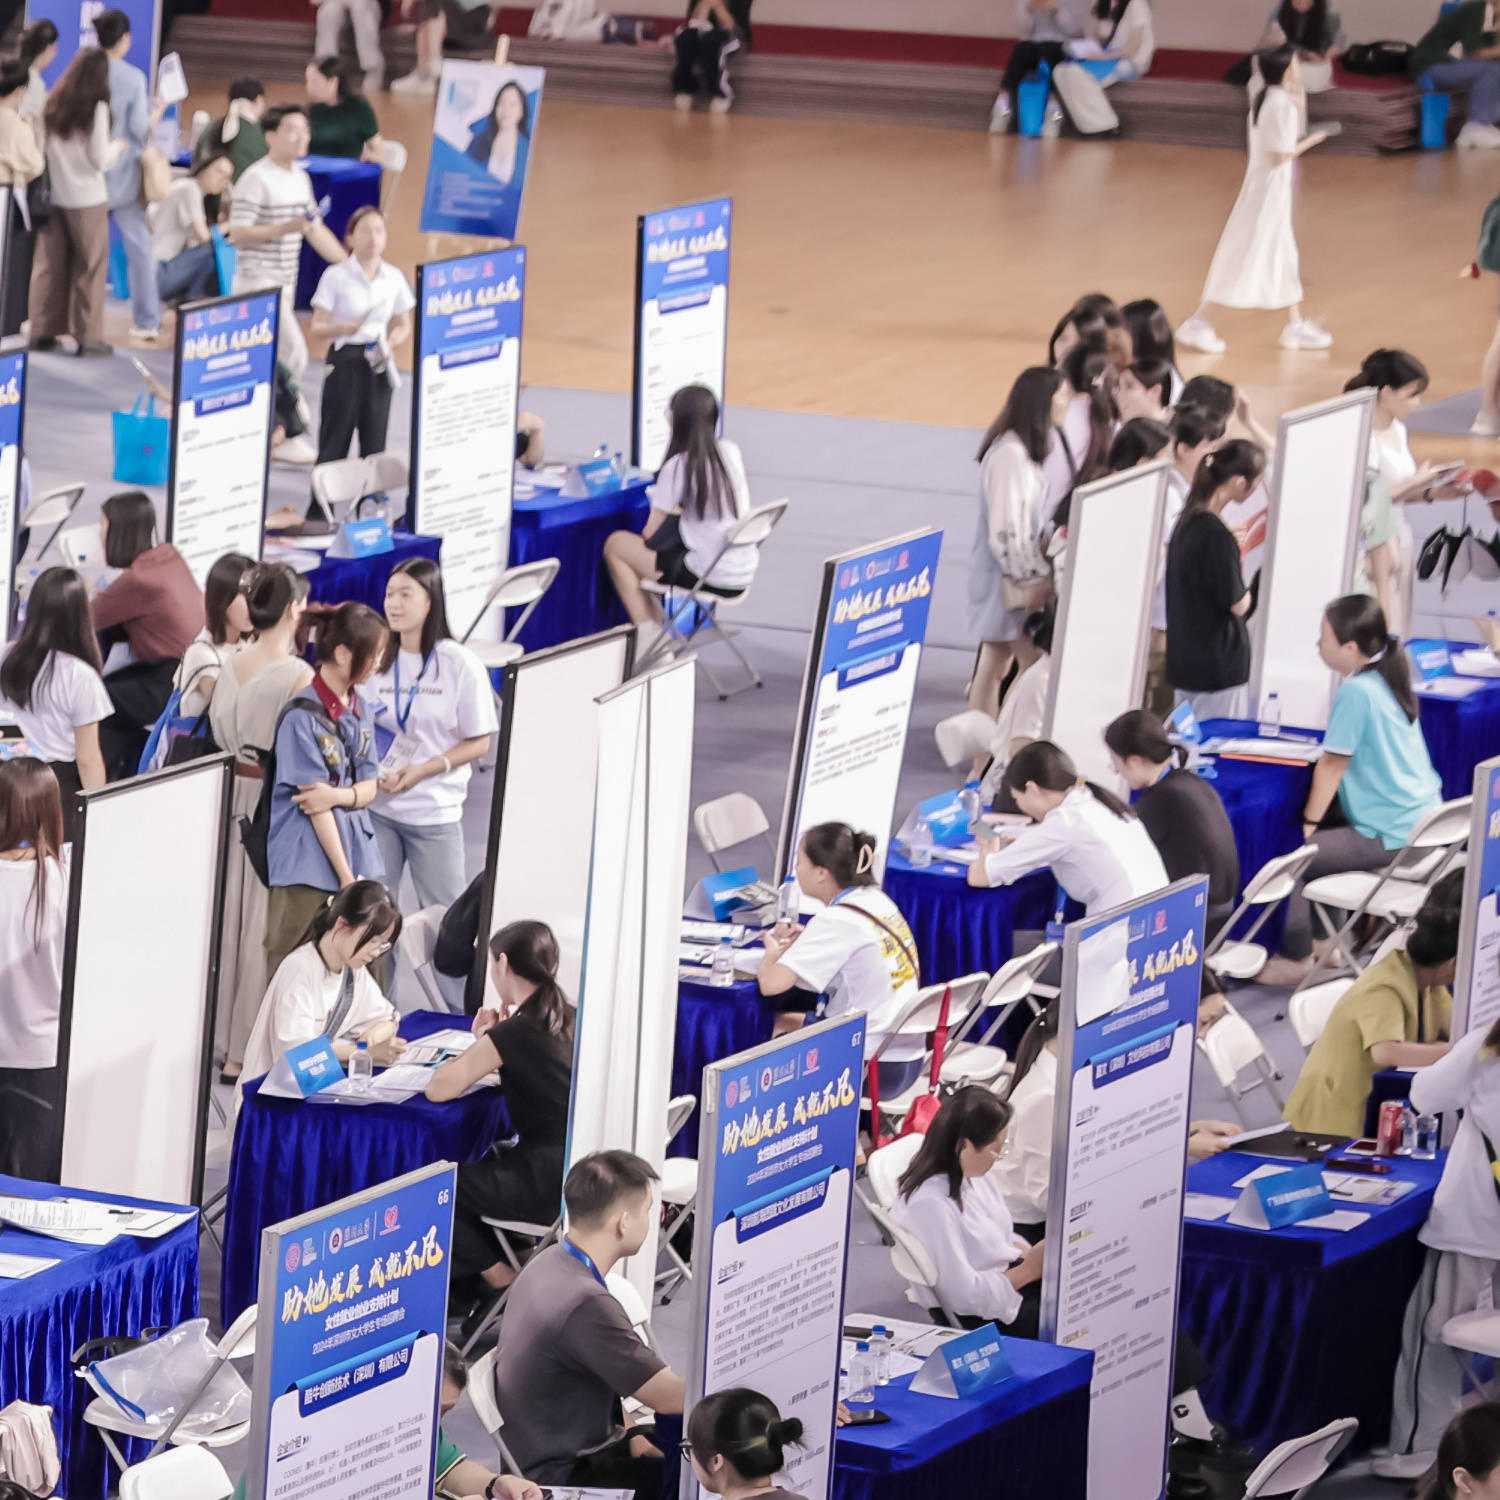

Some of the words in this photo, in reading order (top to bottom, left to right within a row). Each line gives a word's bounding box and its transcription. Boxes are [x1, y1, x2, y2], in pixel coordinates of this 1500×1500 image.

[722, 1101, 789, 1156] 助她发展
[793, 1068, 855, 1125] 成就不凡
[438, 1189, 449, 1205] 66
[281, 1264, 363, 1323] 助她发展
[368, 1225, 443, 1288] 成就不凡
[324, 1288, 399, 1331] 女性就业创业支持计划
